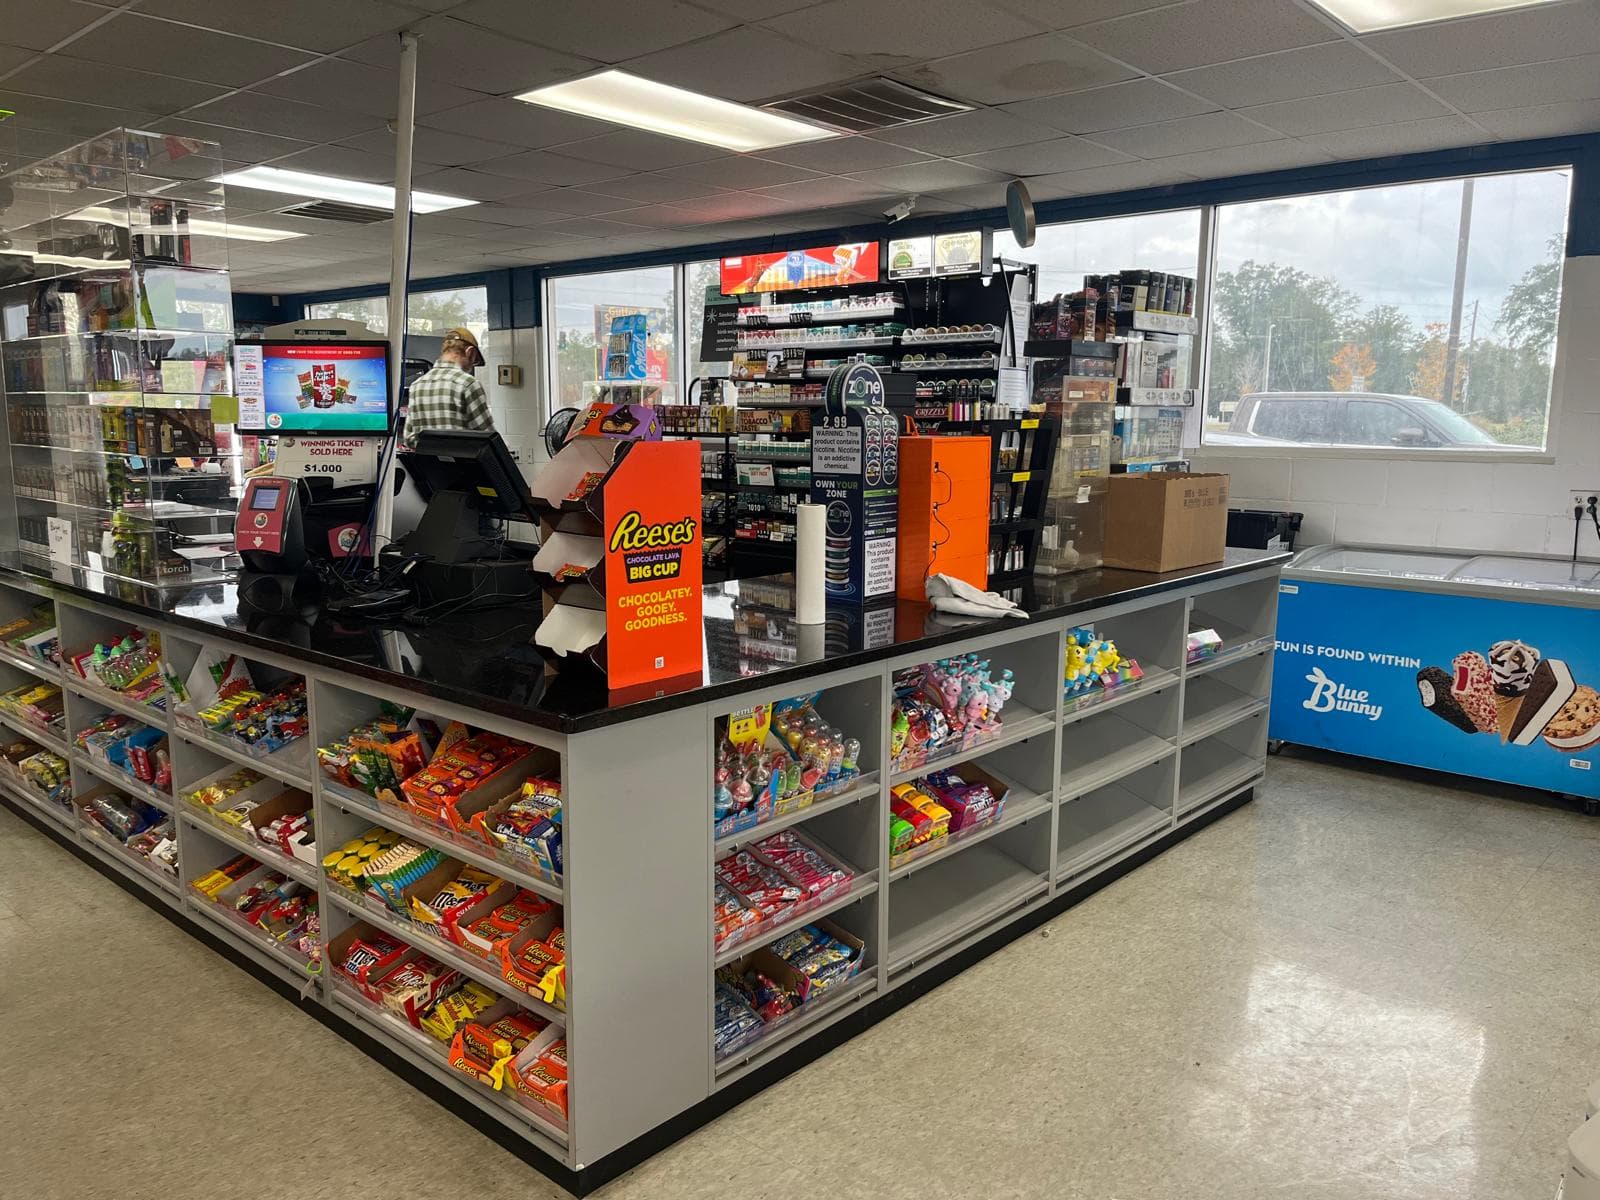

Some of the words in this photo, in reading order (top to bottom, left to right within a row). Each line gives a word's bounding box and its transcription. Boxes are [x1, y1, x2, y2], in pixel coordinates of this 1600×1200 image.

[916, 408, 948, 416] GRIZZLY
[826, 490, 847, 498] ZONE
[610, 512, 696, 552] Reese's
[869, 541, 891, 549] WARNING:
[877, 548, 894, 556] product
[627, 555, 664, 565] CHOCOLATE
[163, 564, 189, 574] torch
[630, 566, 651, 579] BIG
[653, 562, 678, 576] CUP
[618, 587, 693, 608] CHOCOLATEY.
[637, 602, 676, 617] GOOEY.
[625, 612, 687, 631] GOODNESS.
[1275, 641, 1299, 652] FUN
[1303, 644, 1314, 655] IS
[1318, 646, 1365, 661] FOUND
[1368, 653, 1420, 668] WITHIN
